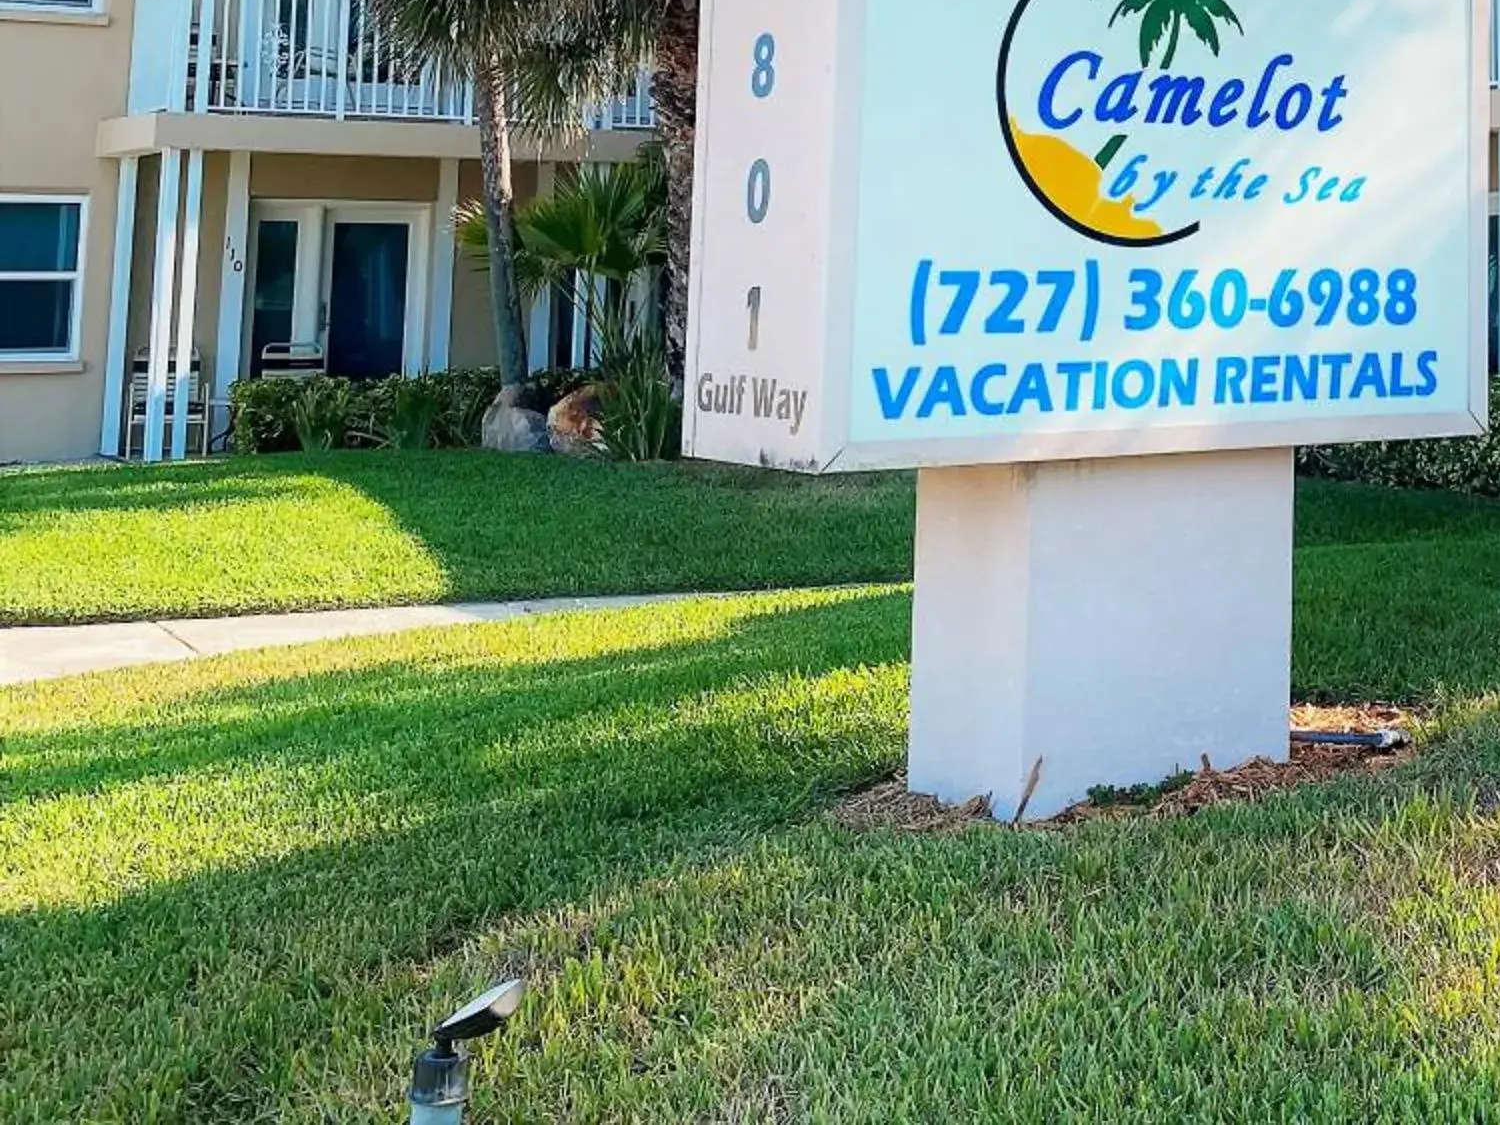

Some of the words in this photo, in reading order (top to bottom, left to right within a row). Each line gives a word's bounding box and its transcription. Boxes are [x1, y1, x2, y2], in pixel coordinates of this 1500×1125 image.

[1037, 50, 1348, 132] Camelot
[1108, 154, 1178, 212] by
[1189, 158, 1269, 200] the
[1283, 166, 1367, 205] Sea
[226, 236, 243, 272] 110
[910, 259, 1099, 346] (727)
[1123, 268, 1417, 331] 360-6988
[697, 373, 746, 415] Gulf
[751, 377, 807, 435] Way
[871, 358, 1199, 420] VACATION
[1214, 350, 1438, 404] RENTALS
